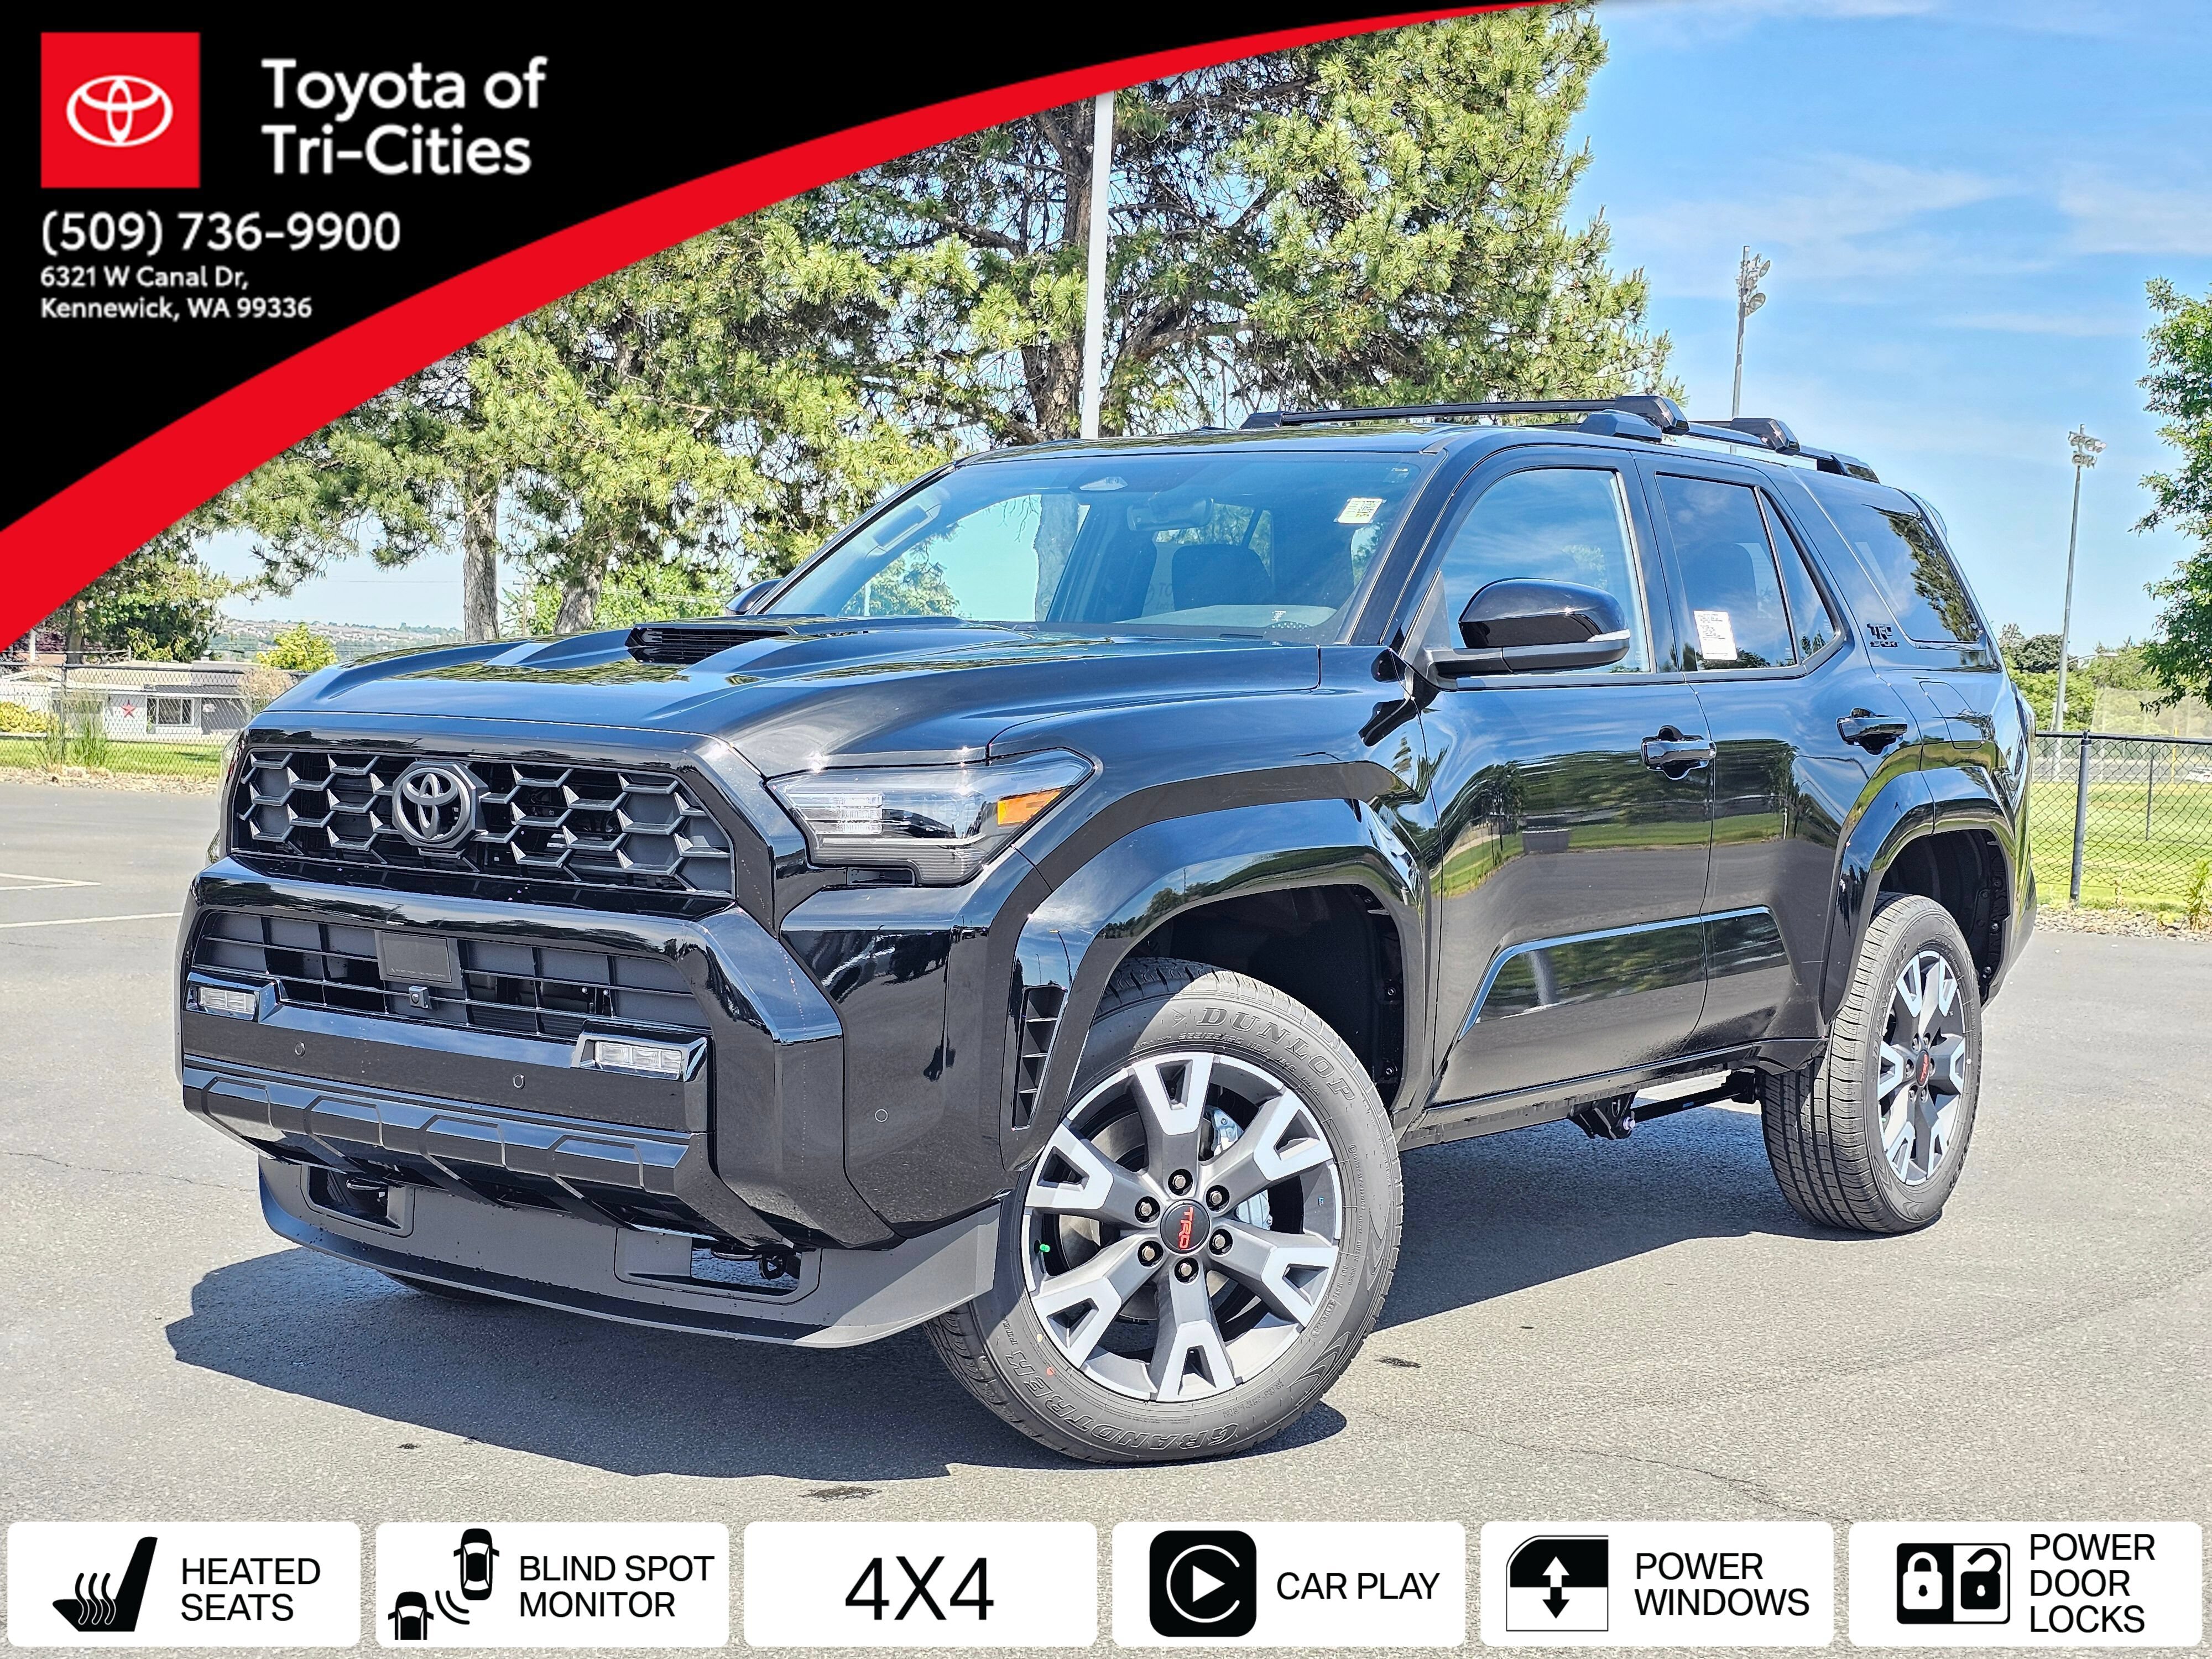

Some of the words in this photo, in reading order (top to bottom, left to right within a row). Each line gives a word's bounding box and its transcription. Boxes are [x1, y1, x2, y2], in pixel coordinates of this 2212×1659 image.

[1196, 1005, 1355, 1102] DUNLOP
[1178, 1206, 1193, 1249] TRD
[1004, 1349, 1239, 1451] GRANDTREK
